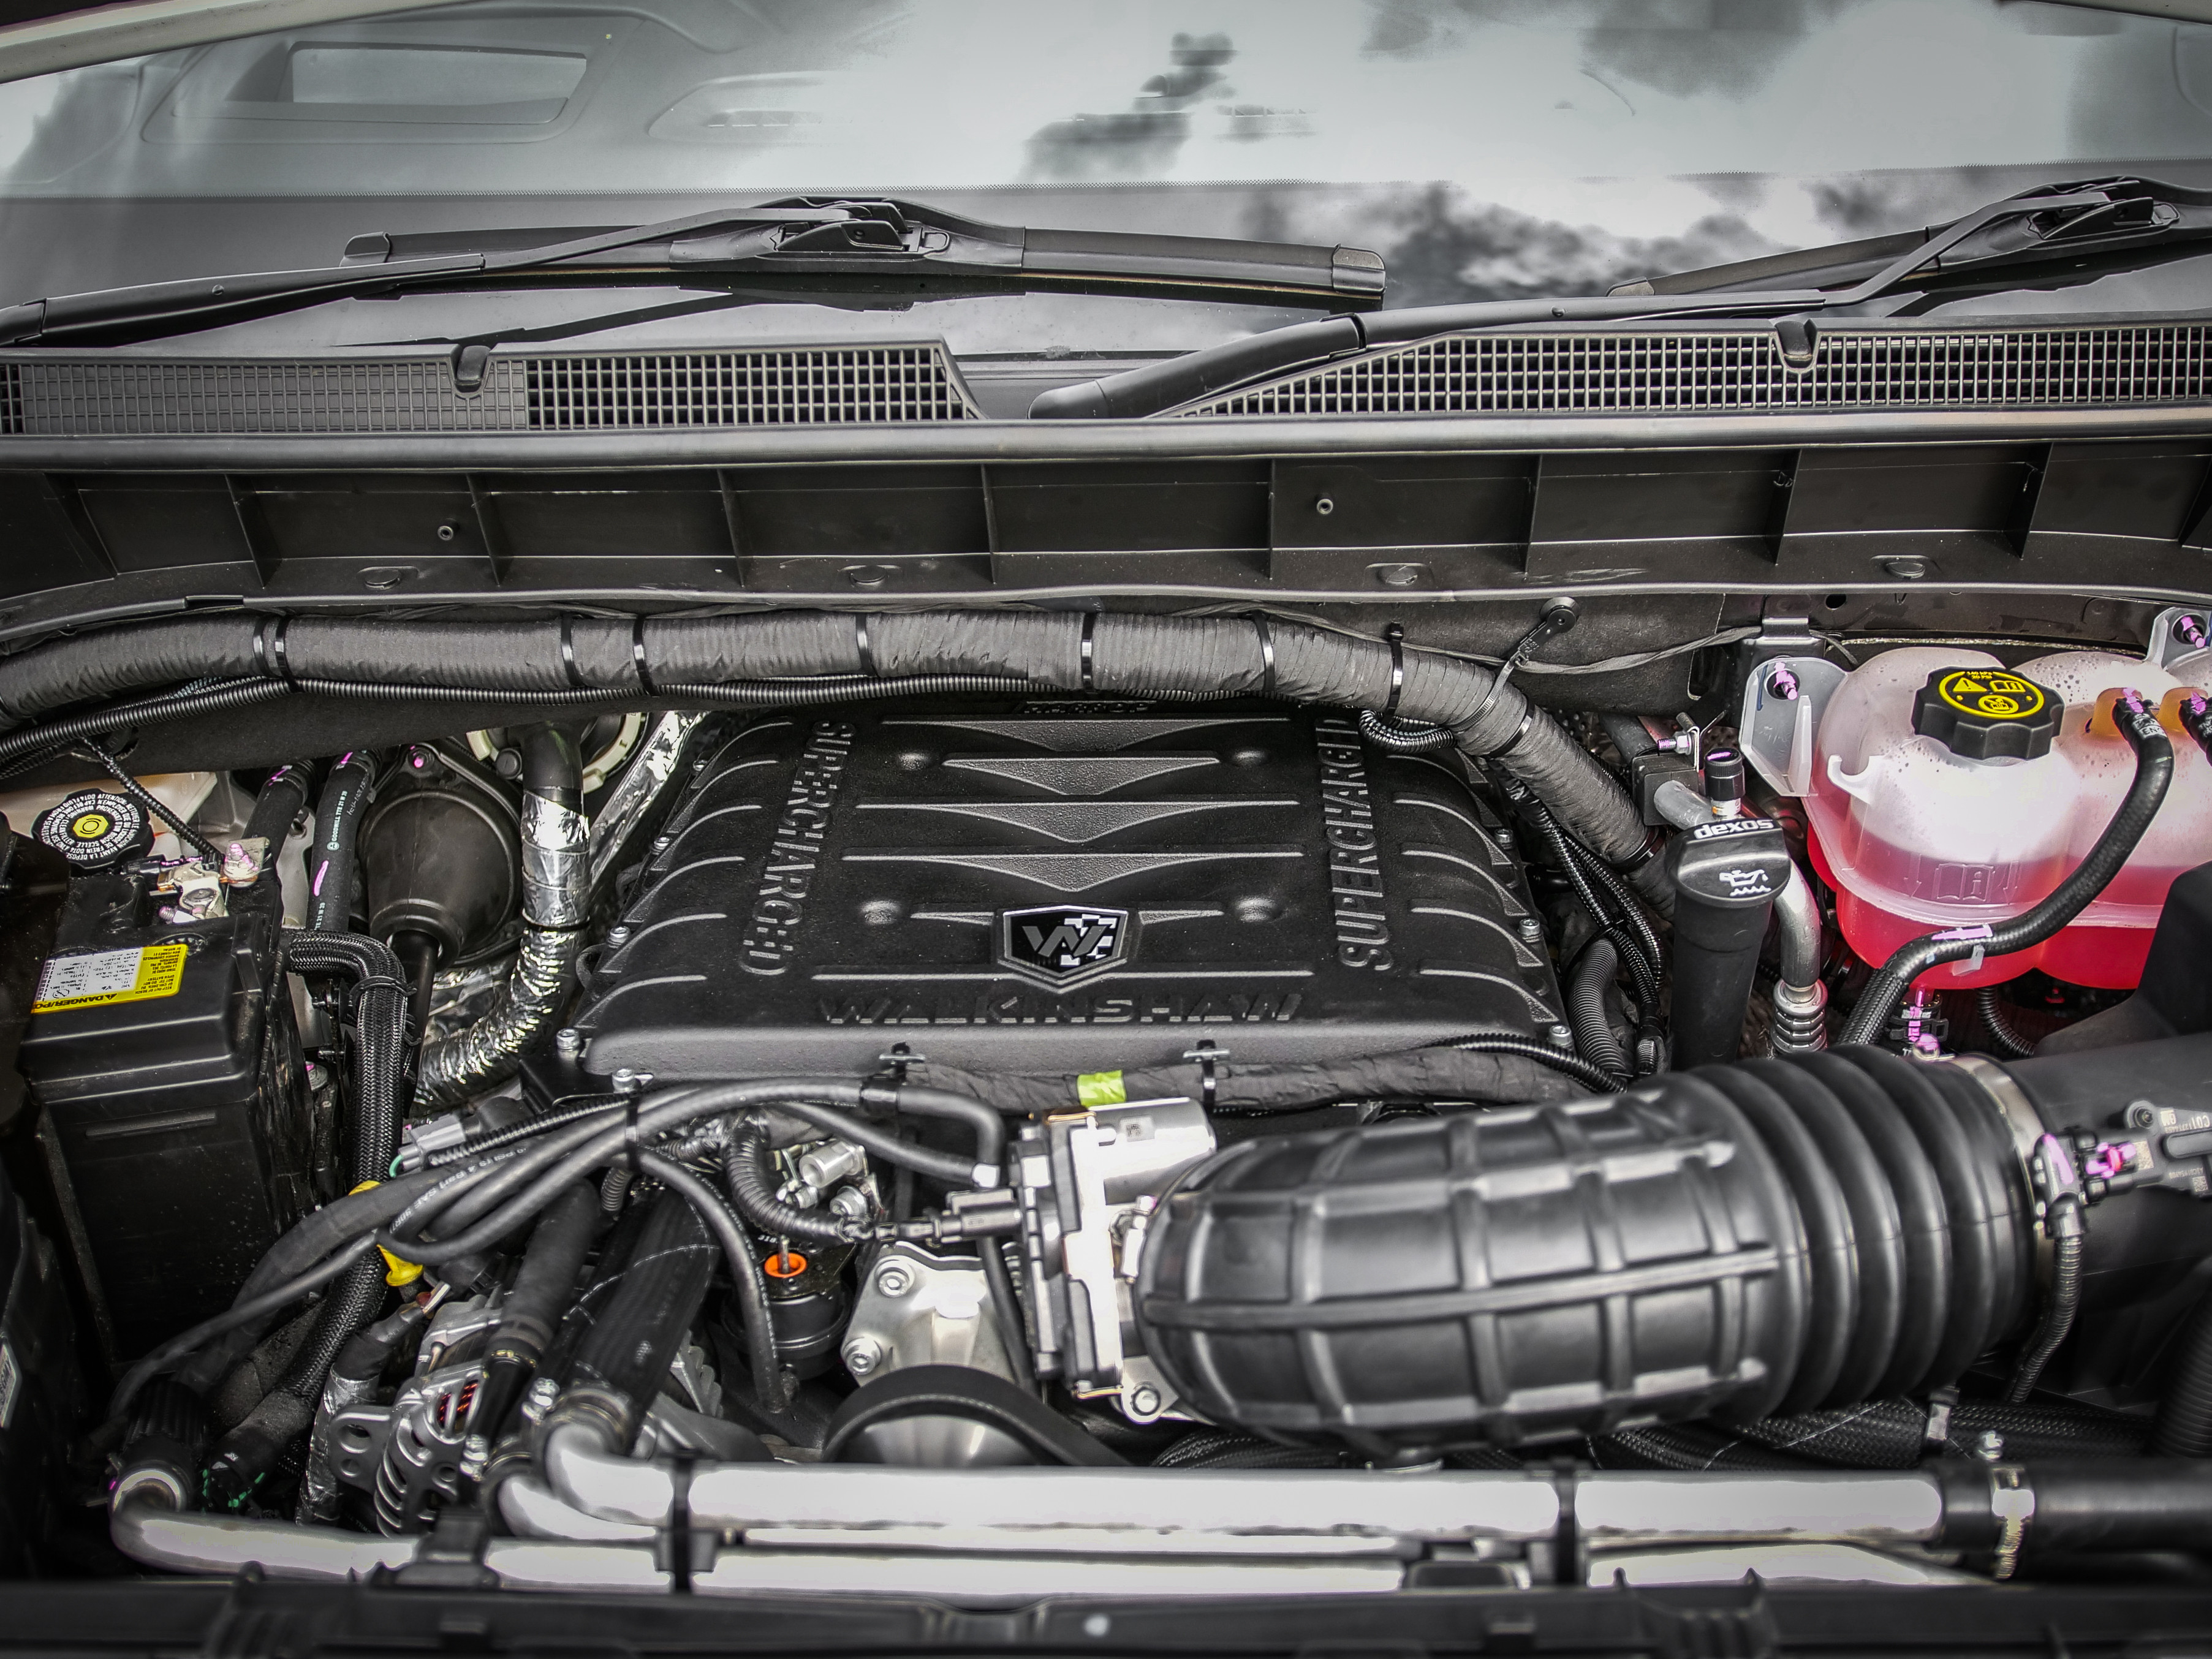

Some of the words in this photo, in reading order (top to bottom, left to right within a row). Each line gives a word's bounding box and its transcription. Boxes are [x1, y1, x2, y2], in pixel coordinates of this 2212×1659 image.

[331, 816, 341, 841] GOODWILL
[1694, 820, 1774, 839] dexos
[86, 845, 104, 854] FREIN
[98, 845, 118, 858] AVANT
[737, 719, 858, 976] SUPERCHARGED
[1316, 717, 1395, 972] SUPERCHARGED
[34, 996, 104, 1009] DANGER/PO
[817, 992, 1304, 1024] WALKINSHAW
